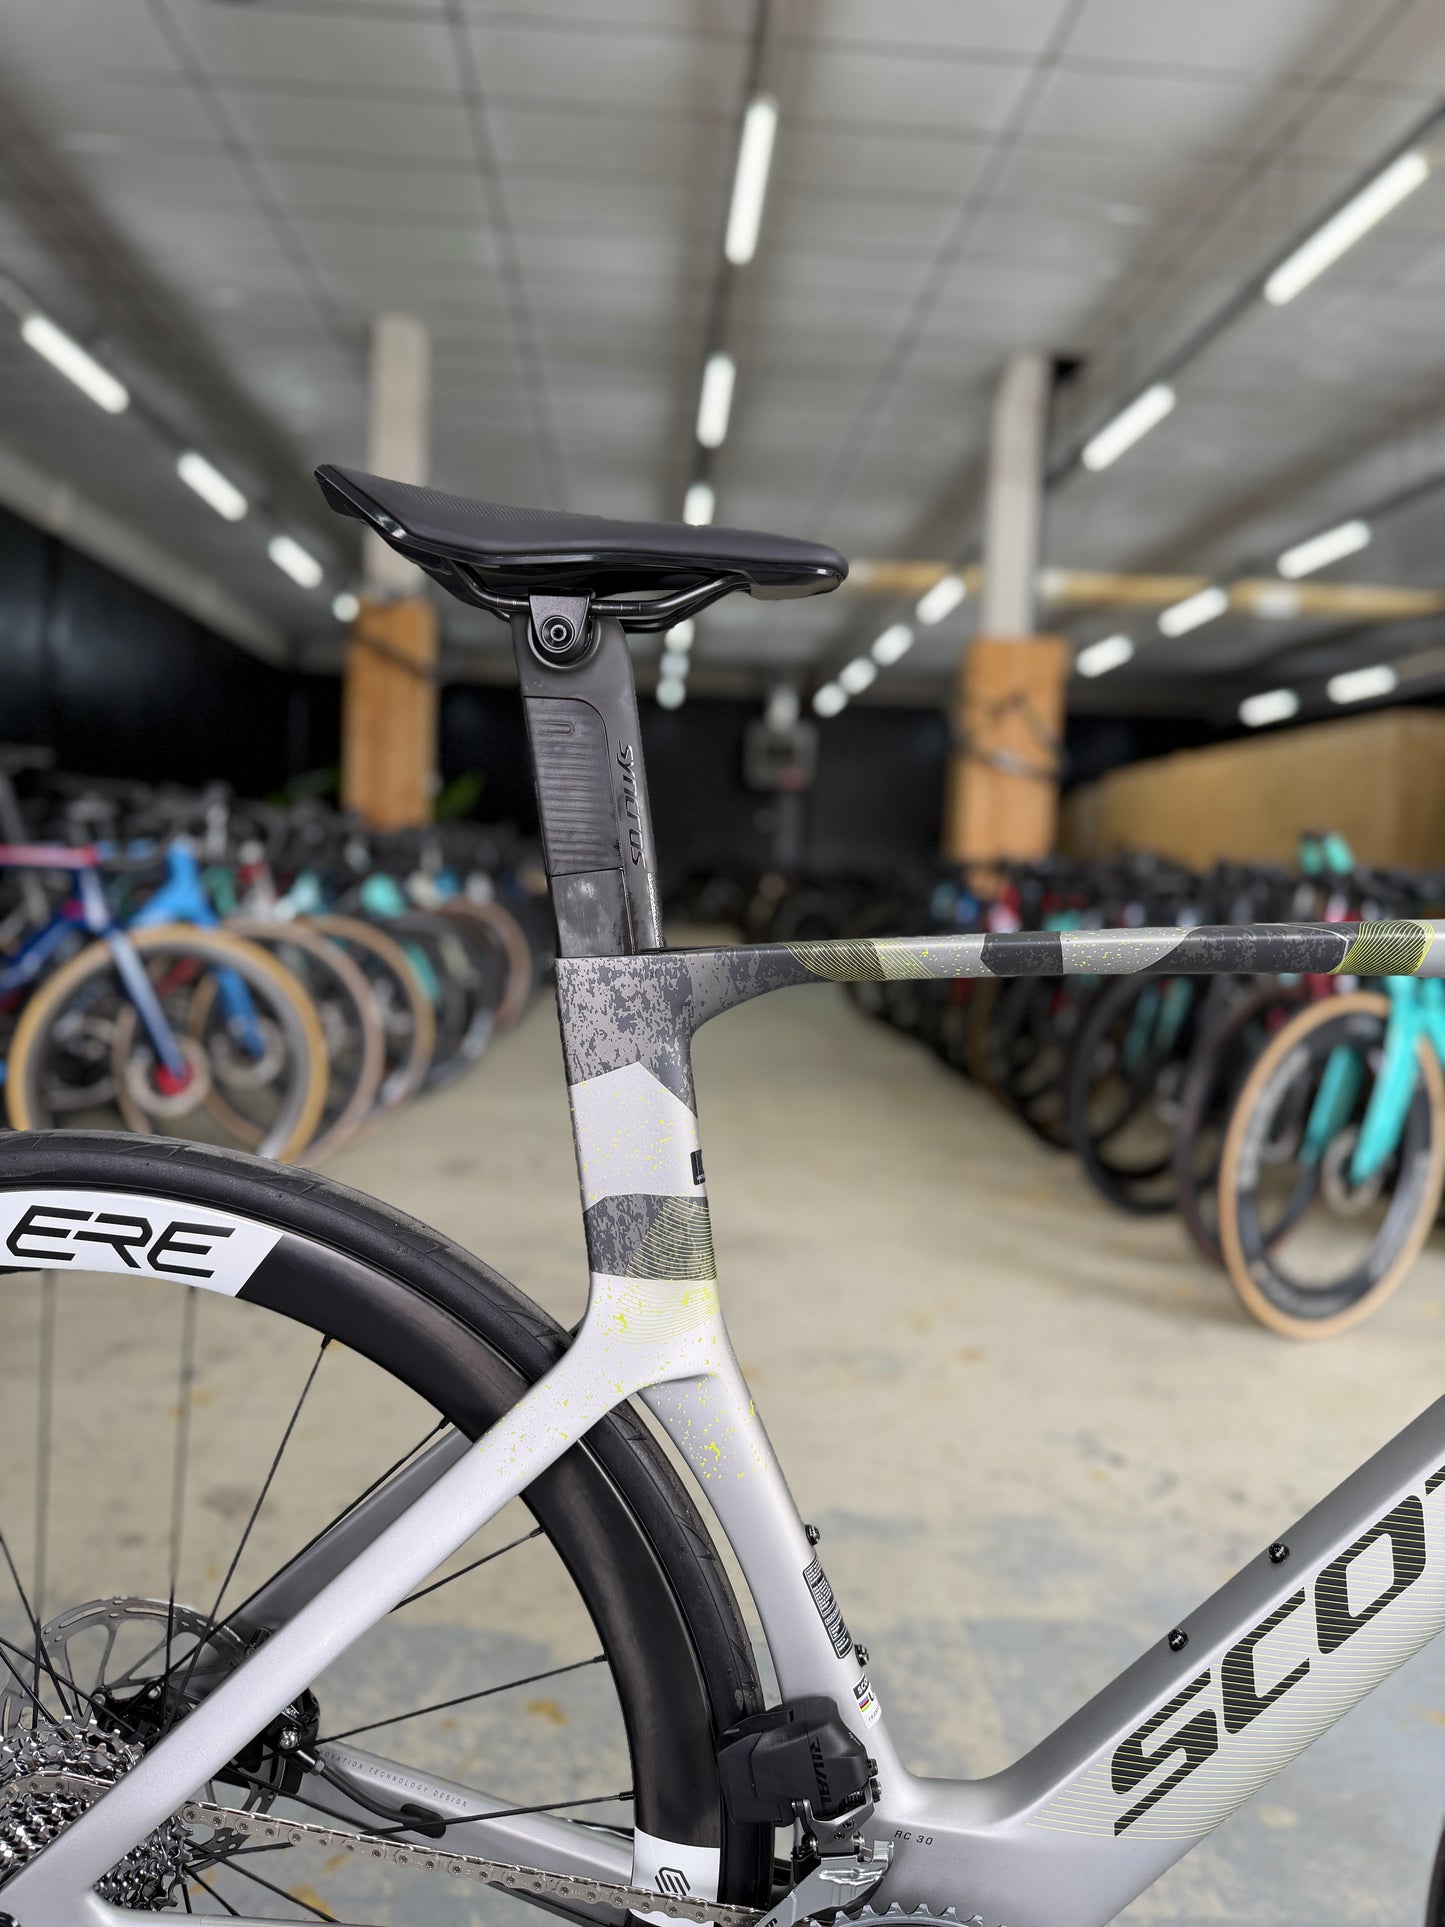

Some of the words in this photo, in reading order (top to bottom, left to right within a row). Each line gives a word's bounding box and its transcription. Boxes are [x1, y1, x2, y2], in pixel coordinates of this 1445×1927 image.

[6, 1205, 236, 1279] ERE
[1111, 1463, 1445, 1838] SCO
[368, 1766, 429, 1794] TECHNOLOGY
[432, 1790, 469, 1808] DESIGN
[894, 1829, 912, 1841] RC
[916, 1834, 934, 1846] 30
